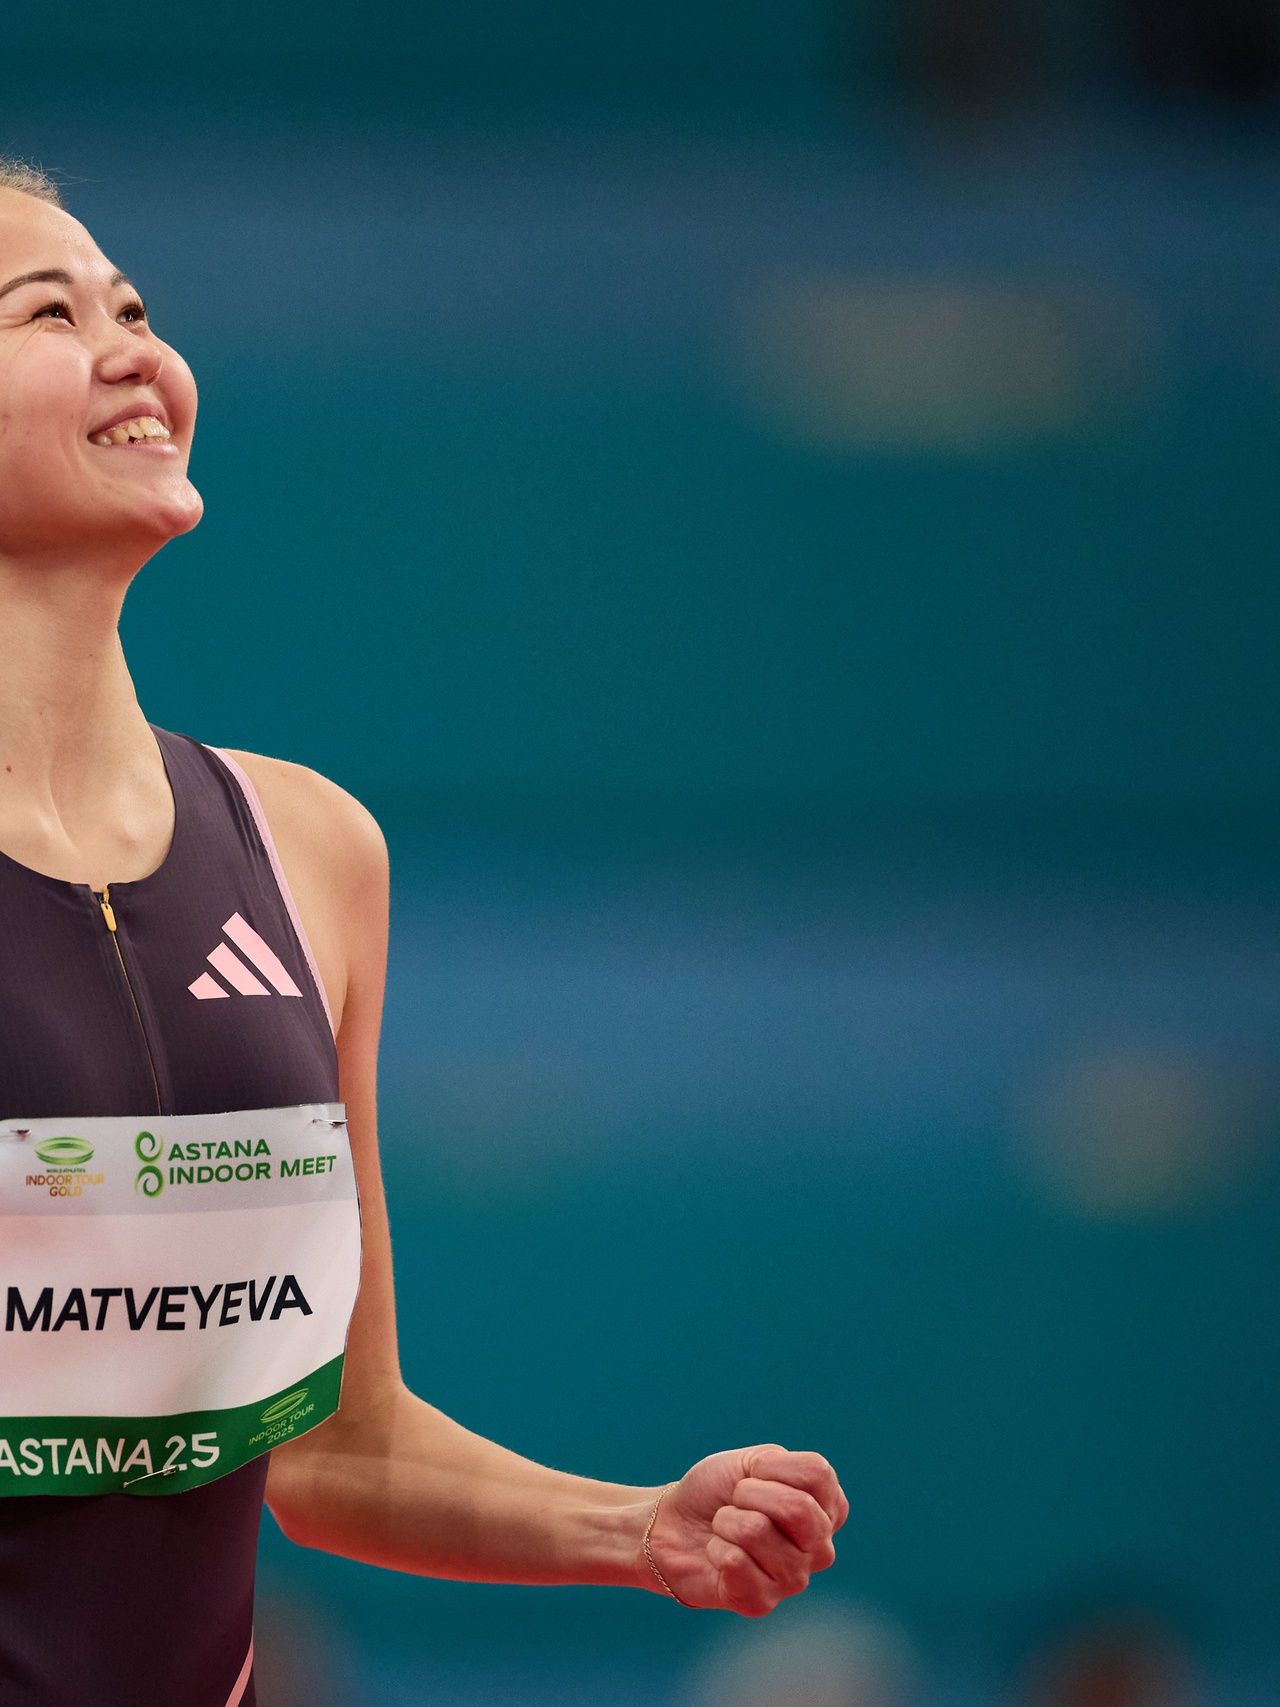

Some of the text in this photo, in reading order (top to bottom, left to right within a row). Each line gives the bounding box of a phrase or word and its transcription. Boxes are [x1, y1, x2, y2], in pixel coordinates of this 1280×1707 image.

[168, 1138, 271, 1161] ASTANA
[25, 1172, 105, 1186] INDOOR TOUR
[169, 1155, 337, 1185] INDOOR MEET
[49, 1185, 83, 1197] GOLD
[5, 1274, 313, 1332] MATVEYEVA
[248, 1418, 287, 1446] INDOOR
[289, 1403, 315, 1423] TOUR
[267, 1423, 295, 1444] 2025
[162, 1431, 220, 1477] 25
